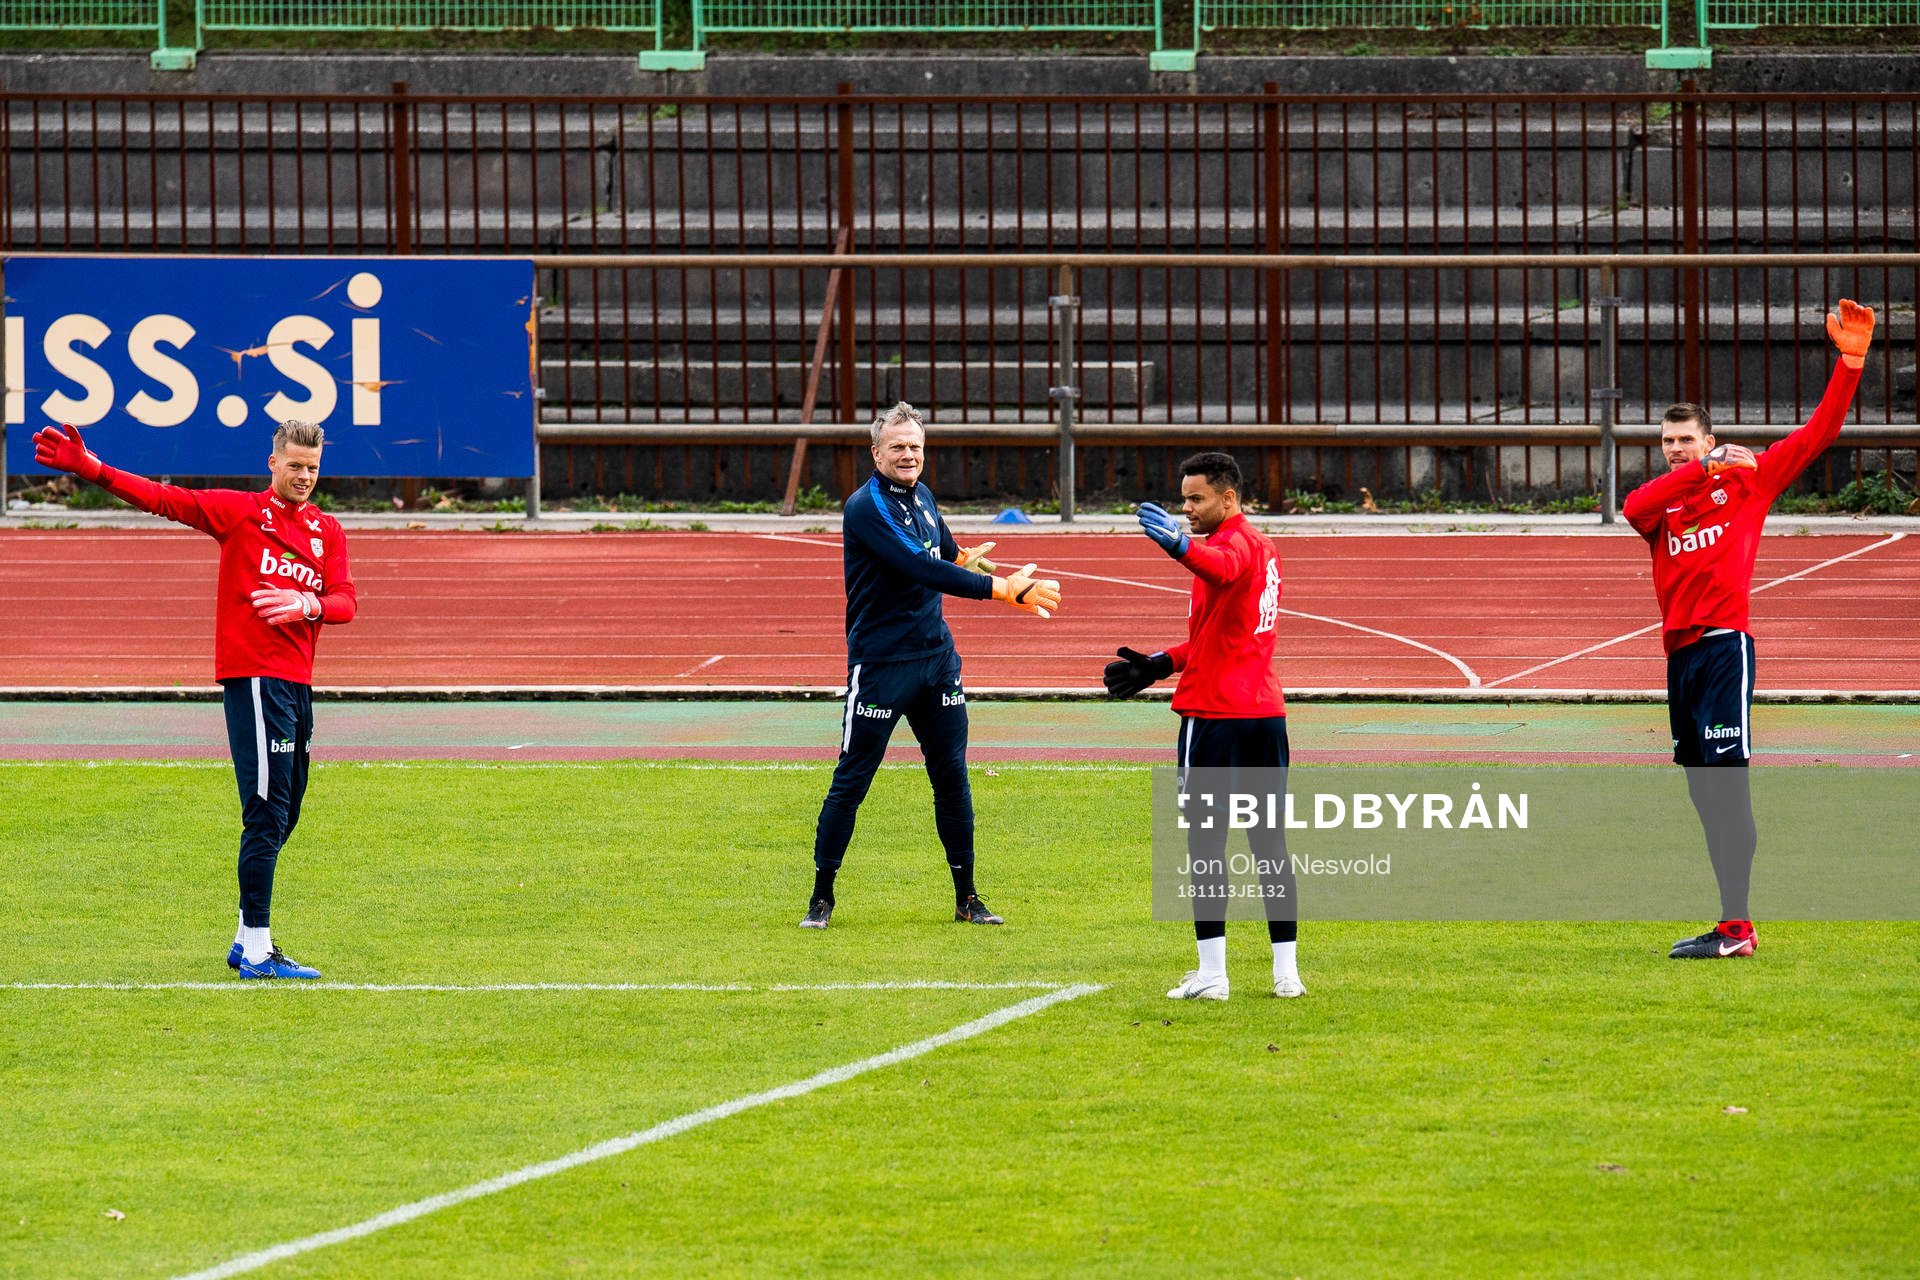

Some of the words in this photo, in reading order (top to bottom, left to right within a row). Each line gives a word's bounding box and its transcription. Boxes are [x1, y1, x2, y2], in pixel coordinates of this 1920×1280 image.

[1667, 523, 1731, 556] bam
[260, 548, 323, 592] bama
[942, 693, 965, 707] bam
[856, 702, 892, 719] bama
[1704, 725, 1741, 740] bama
[271, 739, 295, 753] bam
